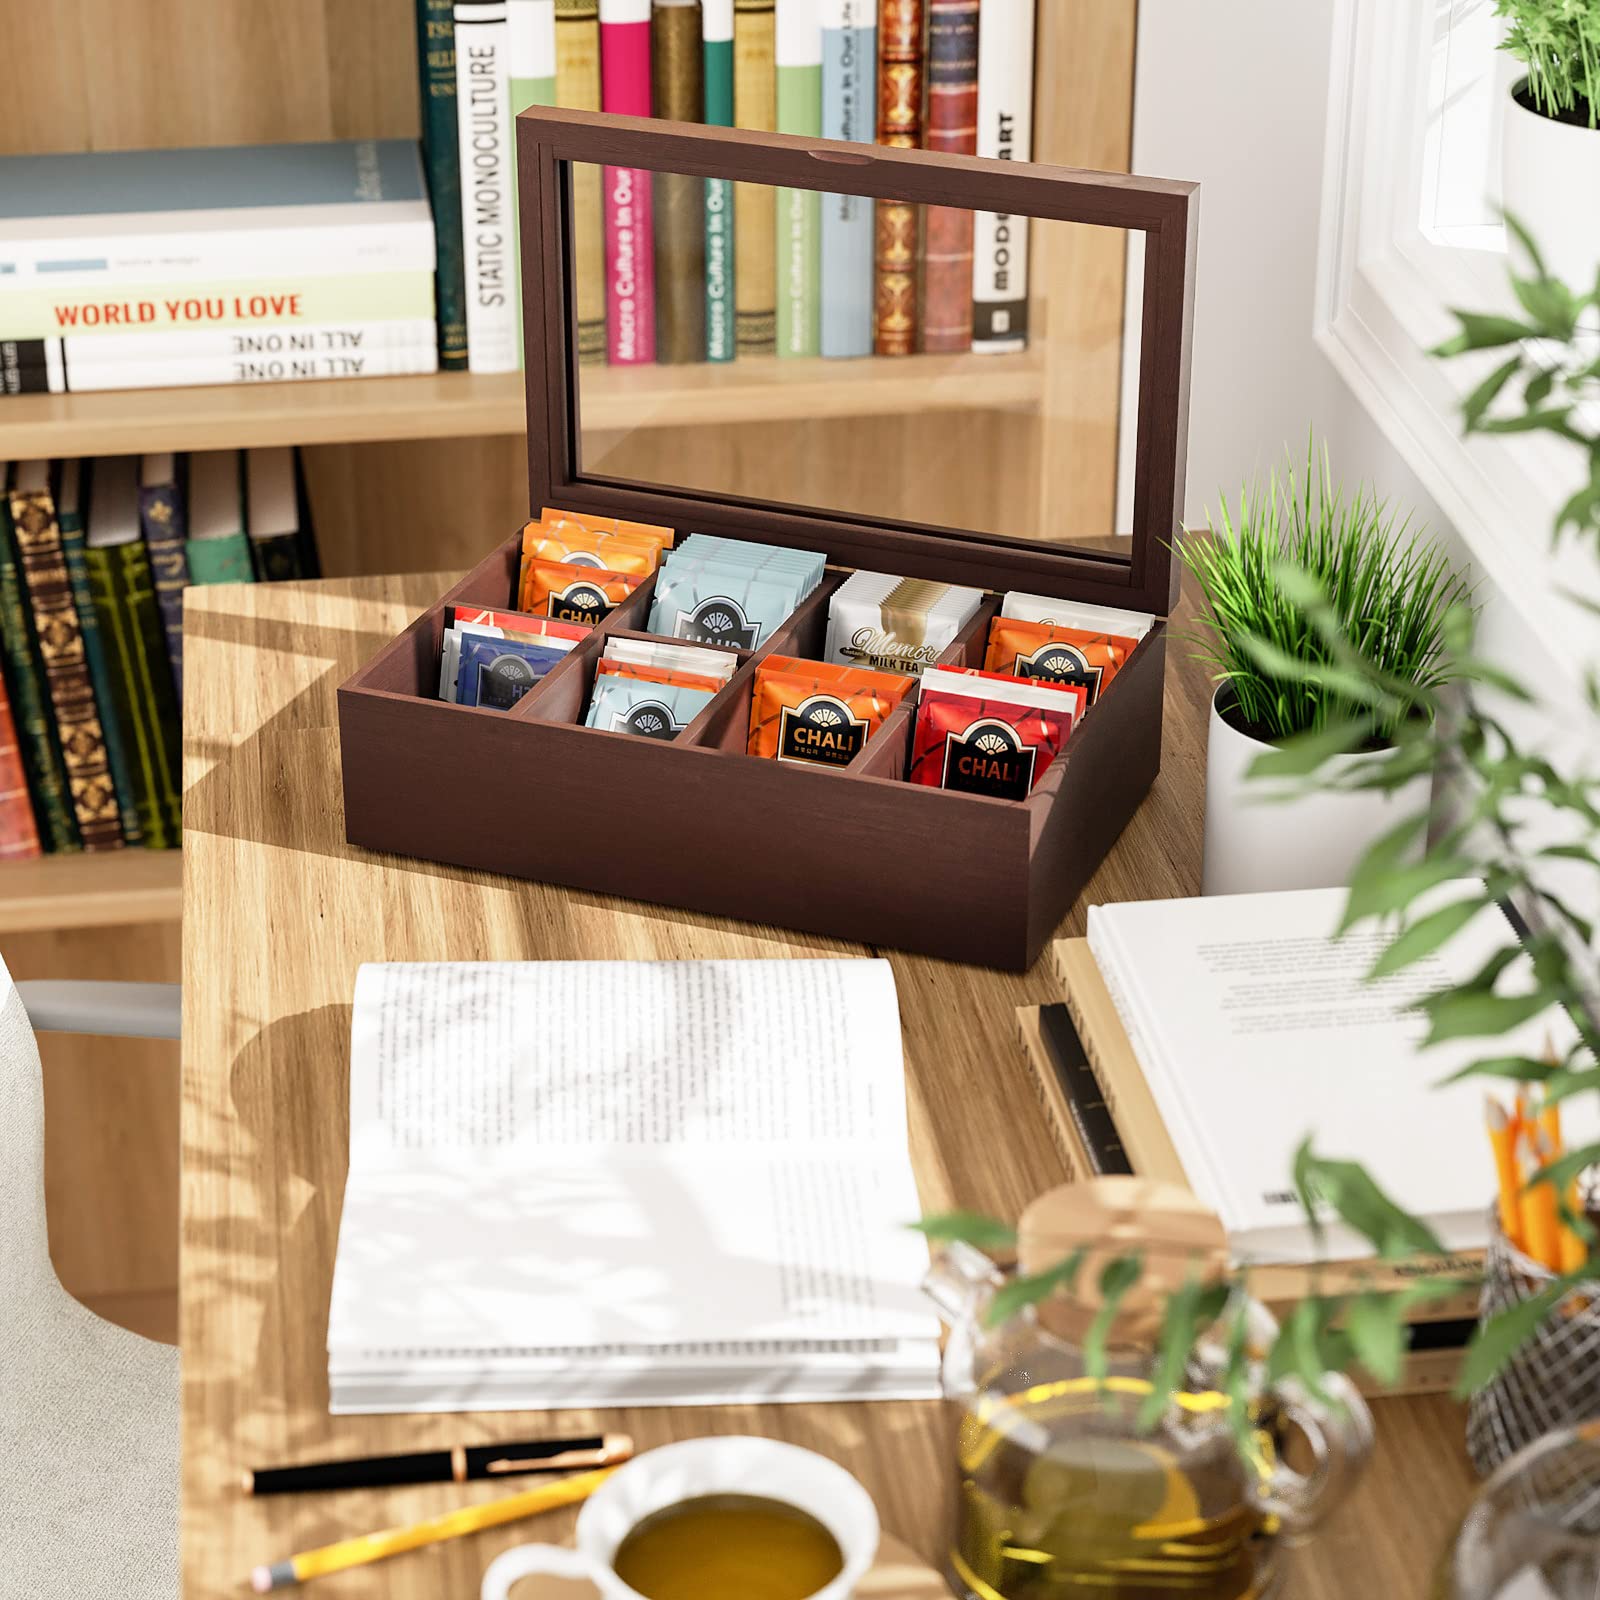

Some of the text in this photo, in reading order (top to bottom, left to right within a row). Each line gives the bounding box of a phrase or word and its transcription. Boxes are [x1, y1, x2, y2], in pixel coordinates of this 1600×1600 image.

[469, 46, 505, 307] STATIC MONOCULTURE
[55, 294, 303, 327] WORLD YOU LOVE
[233, 331, 364, 353] ALL IN ONE
[234, 358, 365, 381] ALL IN ONE
[851, 626, 942, 663] Memor
[869, 655, 919, 673] MILK TEA
[793, 727, 854, 751] CHALI
[958, 756, 1020, 782] CHALI
